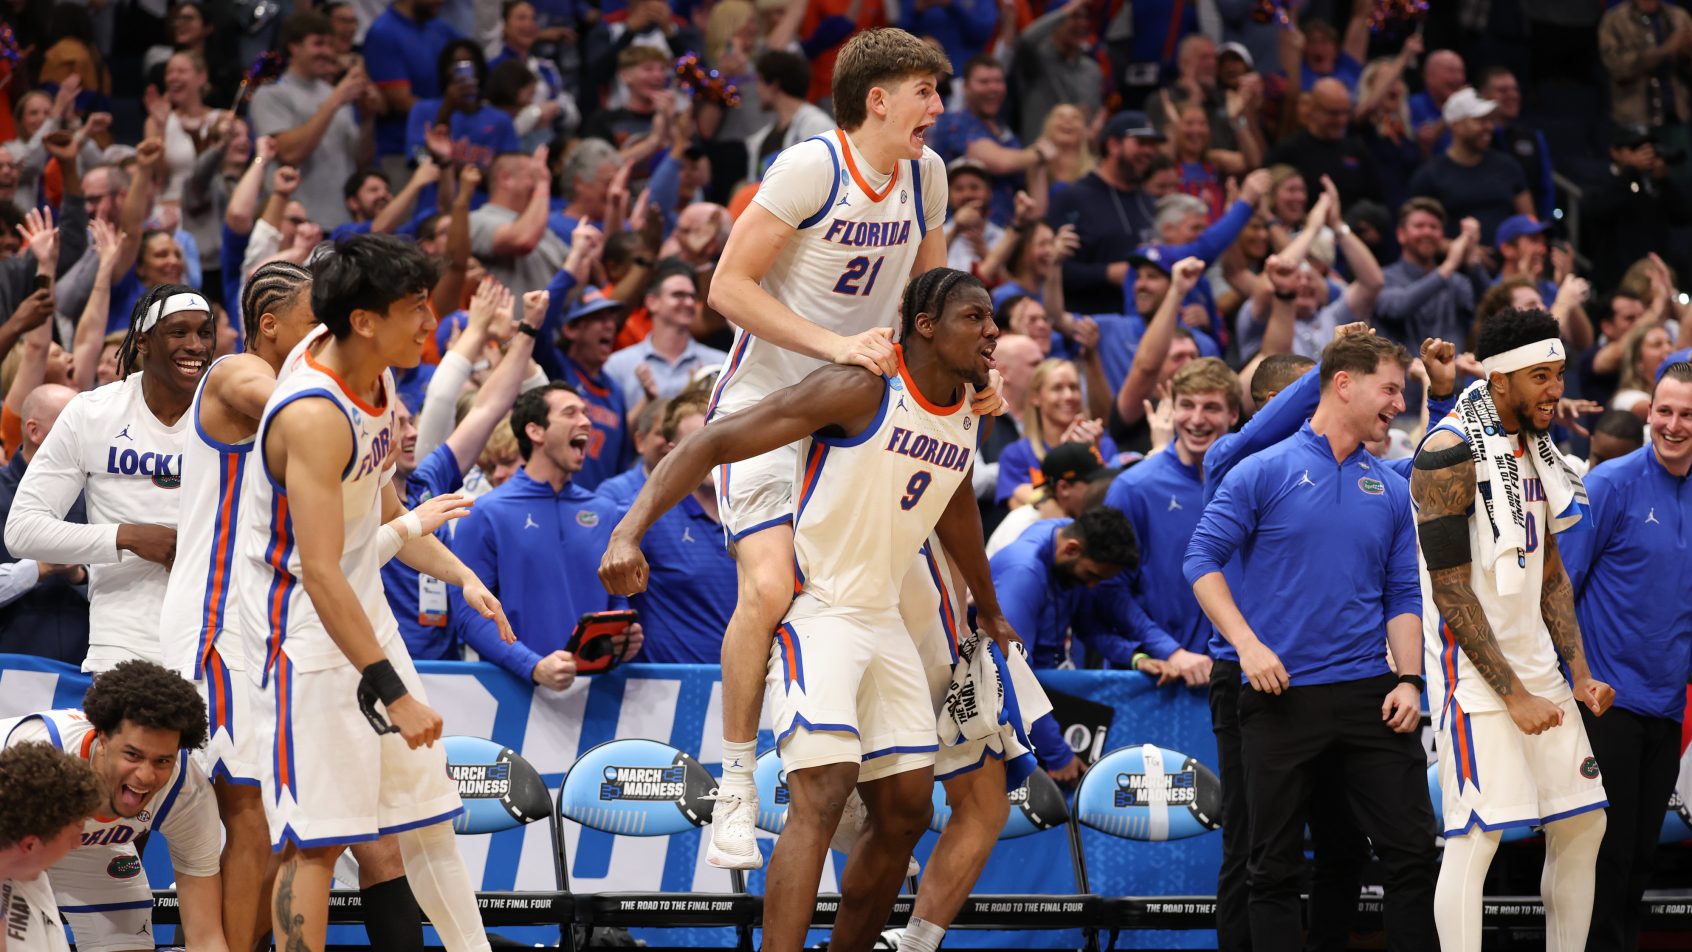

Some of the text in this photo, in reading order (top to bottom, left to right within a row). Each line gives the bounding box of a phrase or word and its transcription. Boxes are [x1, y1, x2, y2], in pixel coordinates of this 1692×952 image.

[821, 217, 912, 248] FLORIDA
[832, 255, 885, 296] 21
[1473, 400, 1494, 427] MARCH
[884, 426, 971, 472] FLORIDA
[1494, 455, 1504, 470] THE
[1500, 471, 1510, 482] TO
[900, 469, 932, 511] 9
[1504, 453, 1525, 529] FINAL FOUR
[1505, 484, 1516, 509] ROAD
[961, 681, 979, 719] FINAL
[955, 707, 968, 724] THE
[450, 766, 486, 780] ARCH
[617, 768, 662, 782] MARCH
[459, 780, 509, 794] ADNESS
[623, 782, 684, 796] MADNESS
[328, 897, 346, 906] INAL
[478, 899, 552, 909] TO THE FINAL FOUR
[620, 901, 733, 911] THE ROAD TO THE FINAL FOUR
[816, 902, 838, 912] ROAD
[892, 903, 911, 913] OUR
[975, 902, 1084, 912] THE ROAD TO THE FINAL FOUR
[1146, 904, 1161, 913] THE
[1162, 904, 1184, 913] ROAD
[1184, 904, 1195, 913] TO
[1195, 904, 1211, 913] THE
[1484, 905, 1499, 915] THE
[1500, 905, 1520, 915] ROAD
[1521, 905, 1531, 915] TO
[1651, 904, 1665, 914] THE
[1665, 904, 1686, 914] ROAD
